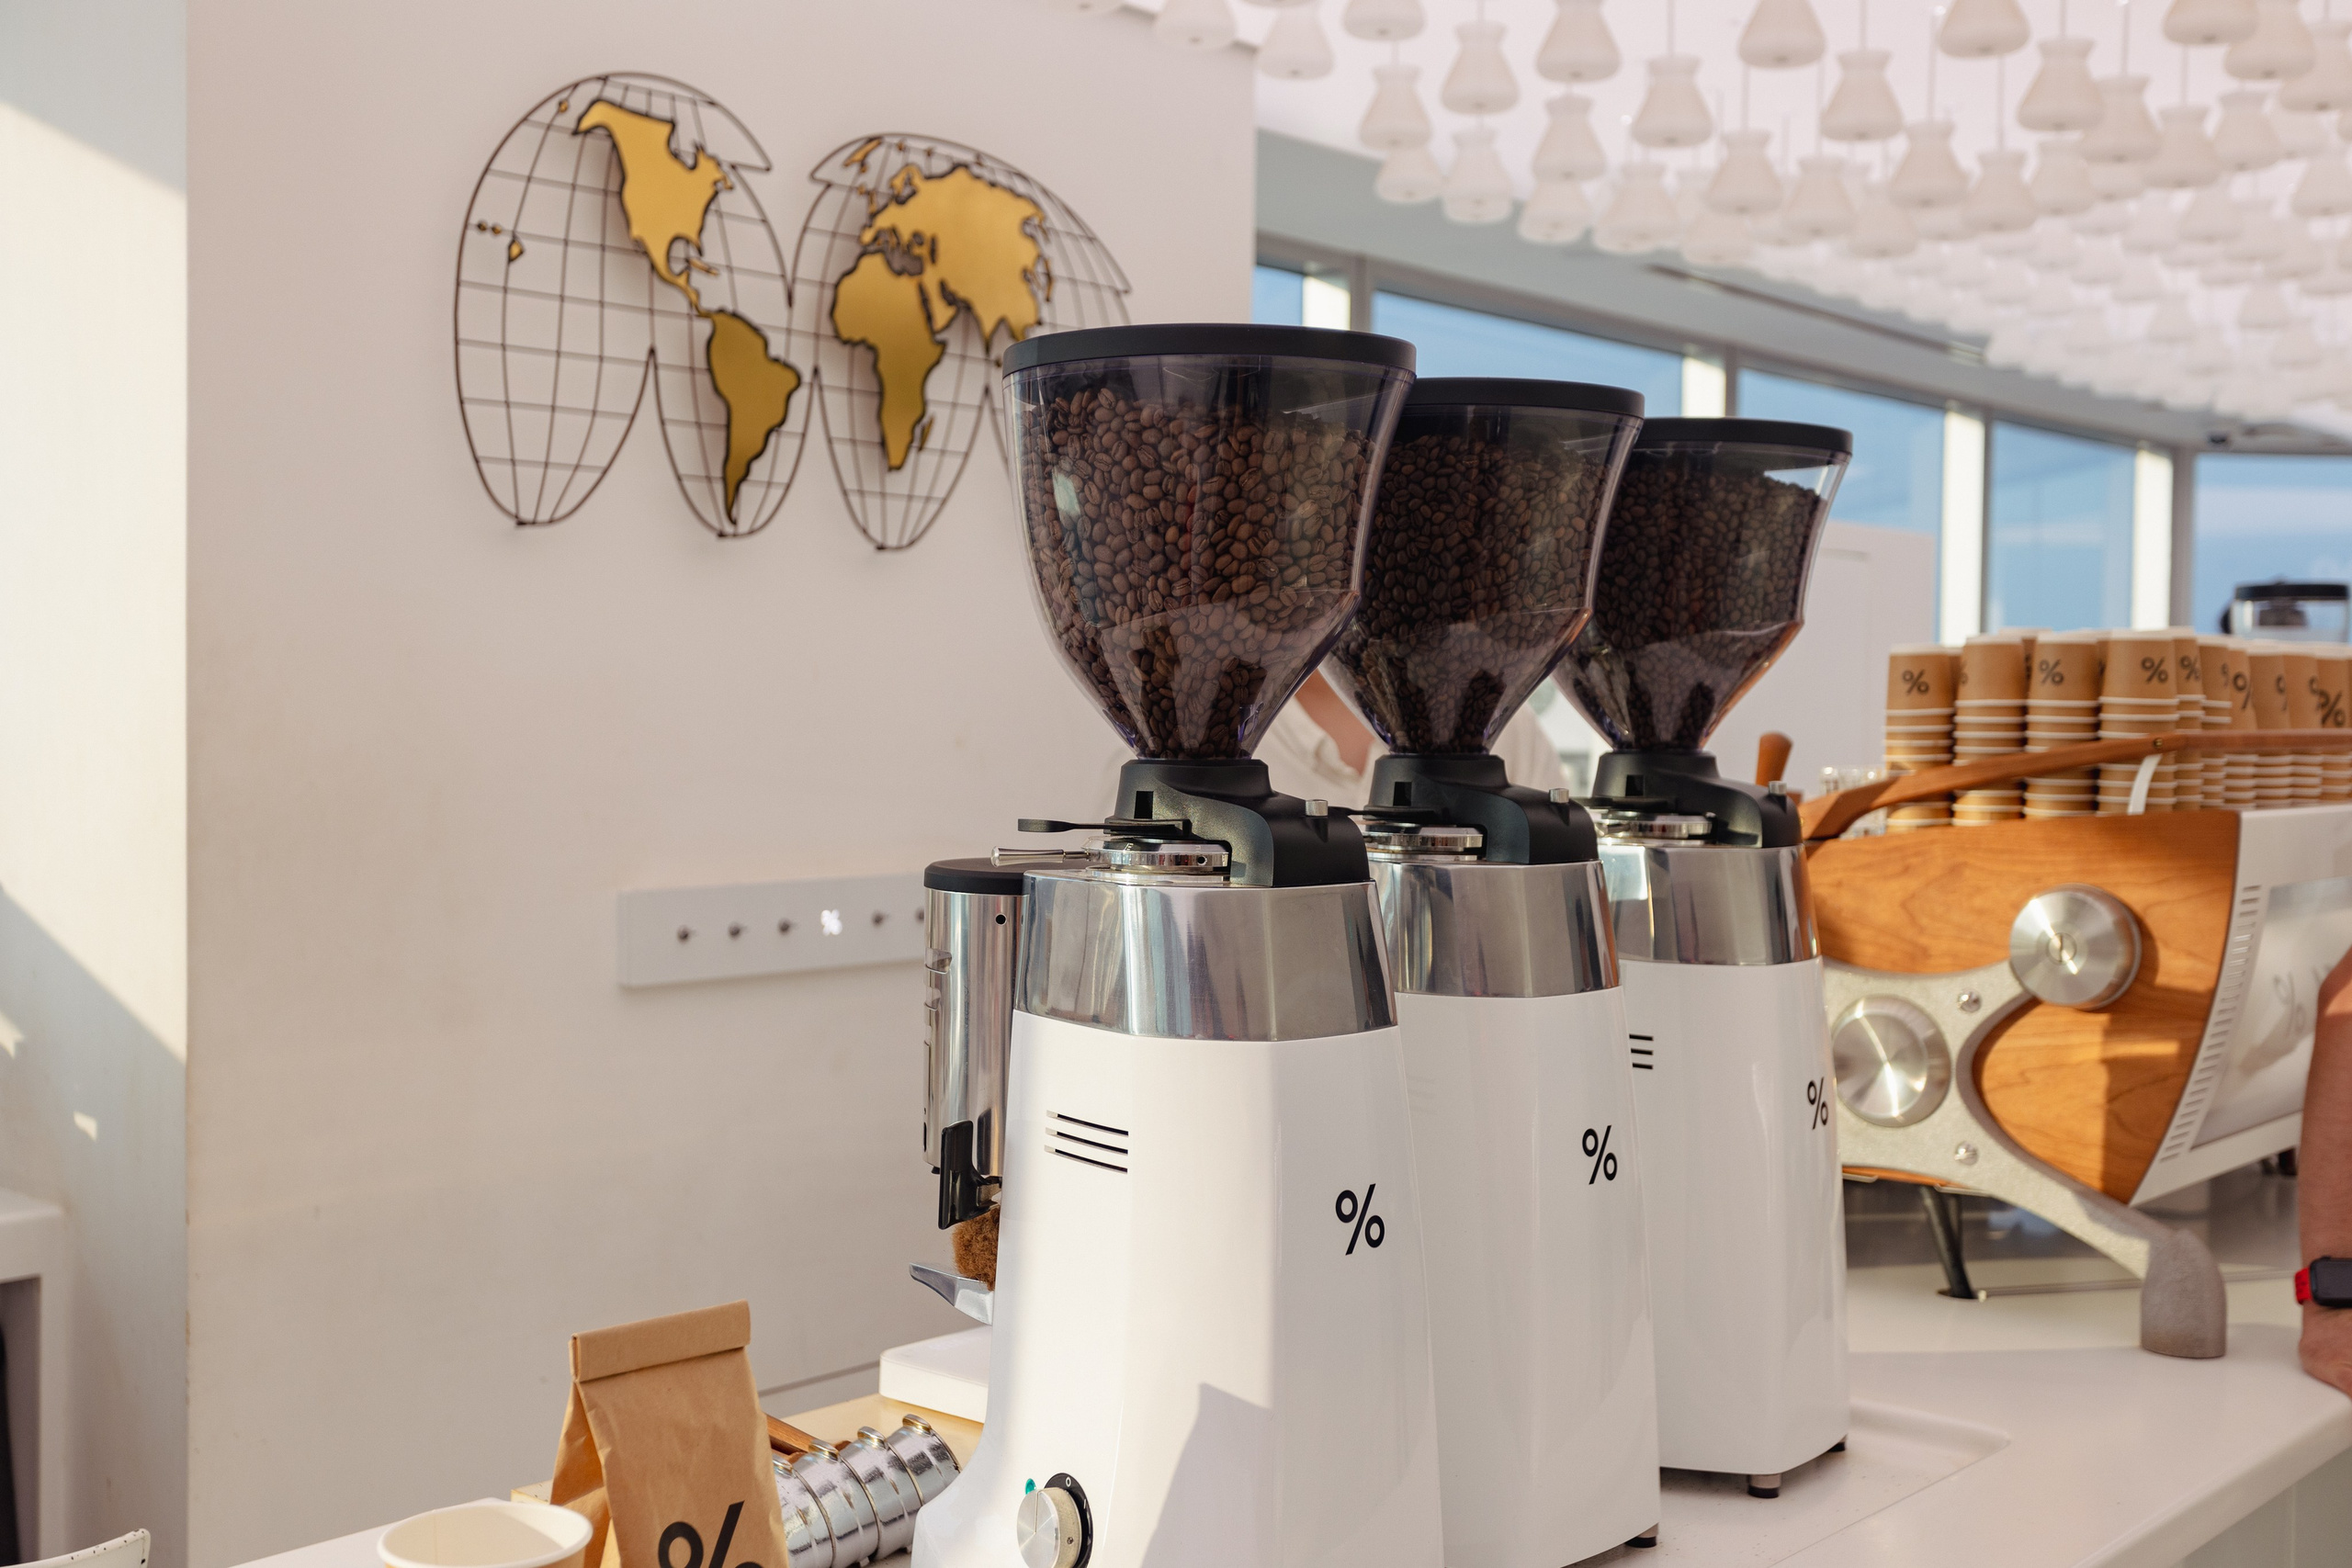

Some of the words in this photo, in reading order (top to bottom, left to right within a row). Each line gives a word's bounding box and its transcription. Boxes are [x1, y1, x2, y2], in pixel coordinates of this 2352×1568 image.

[1902, 669, 1930, 695] %
[2039, 658, 2065, 686] %
[2140, 656, 2169, 685] %
[1806, 1077, 1829, 1131] %
[1581, 1124, 1619, 1186] %
[1335, 1182, 1385, 1257] %
